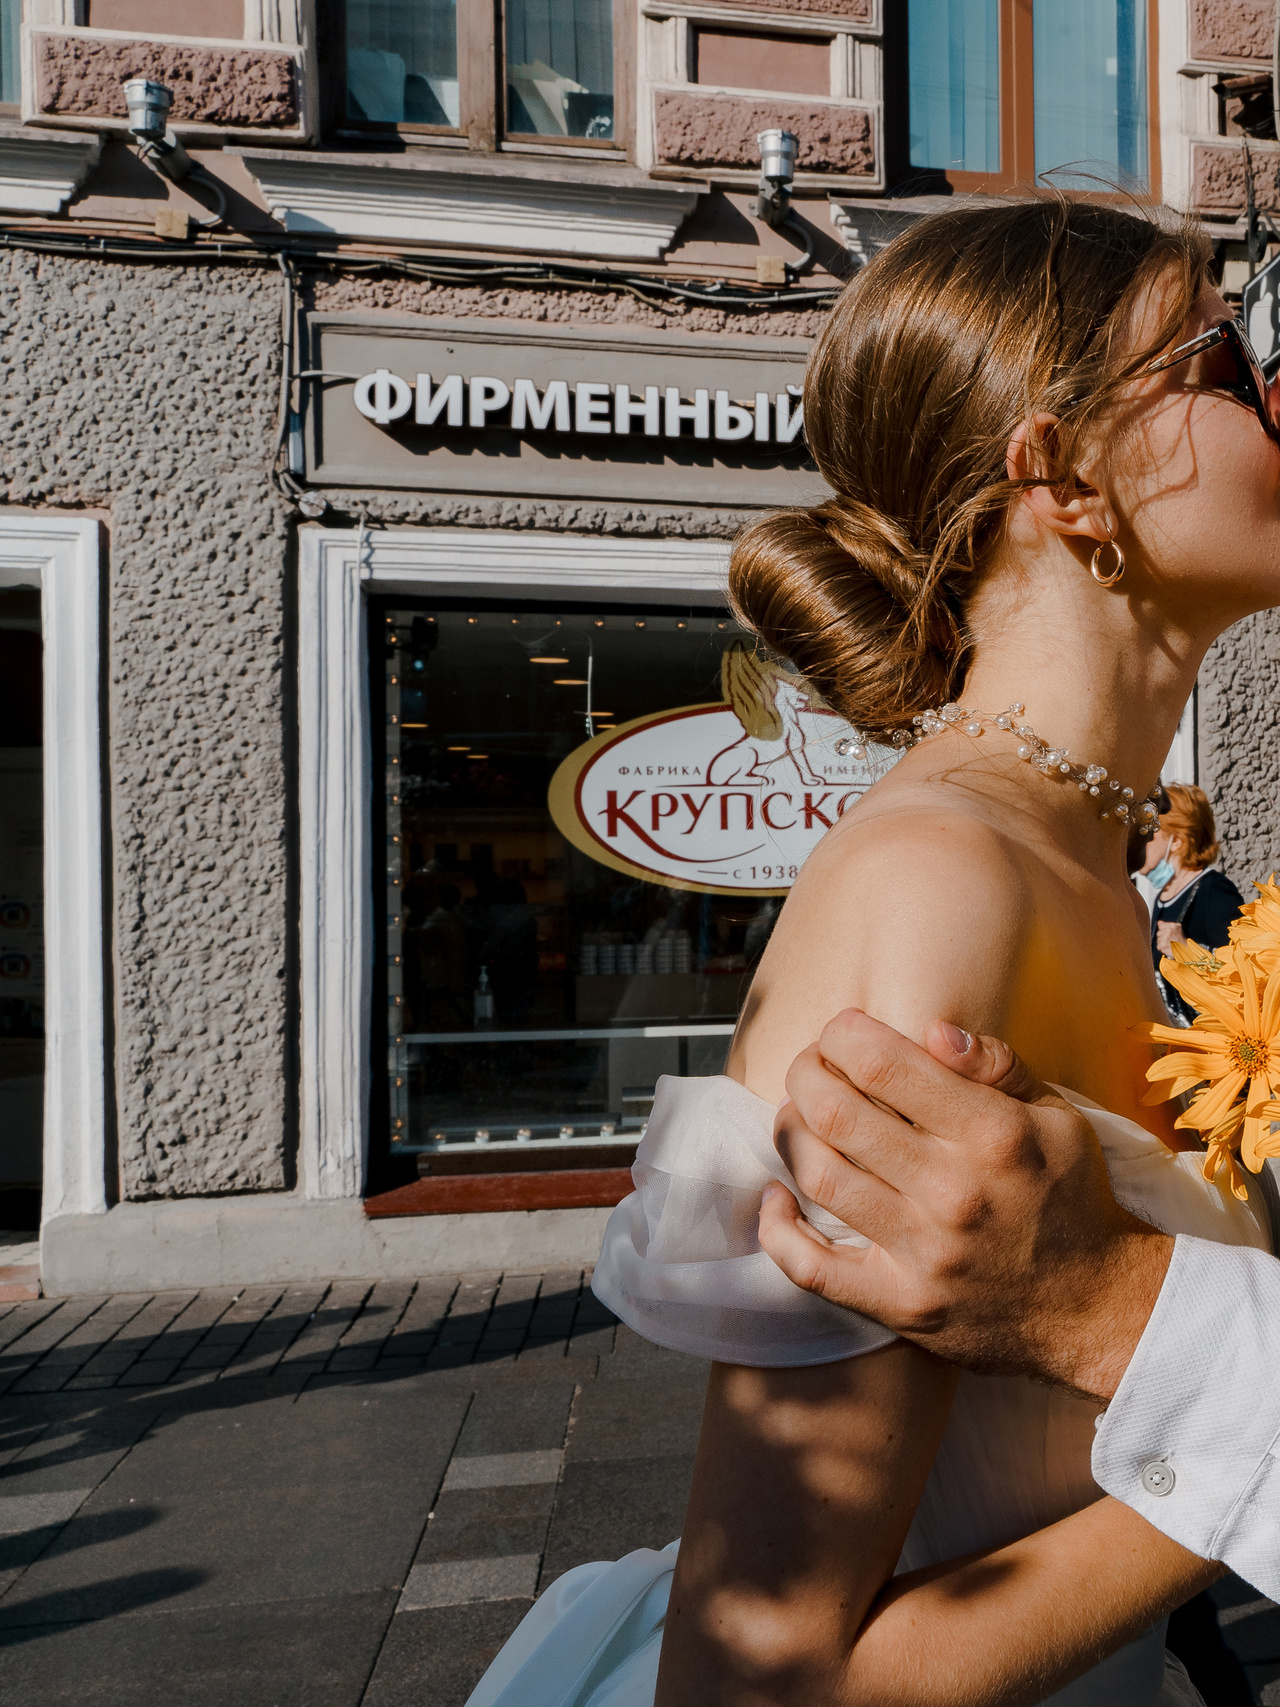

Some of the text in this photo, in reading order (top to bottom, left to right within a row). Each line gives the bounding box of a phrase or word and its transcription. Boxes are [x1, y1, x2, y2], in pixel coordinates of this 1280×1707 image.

[353, 368, 805, 443] ФИРМЕННЫЙ
[618, 765, 702, 776] ФАБРИКА
[749, 864, 799, 880] 1938
